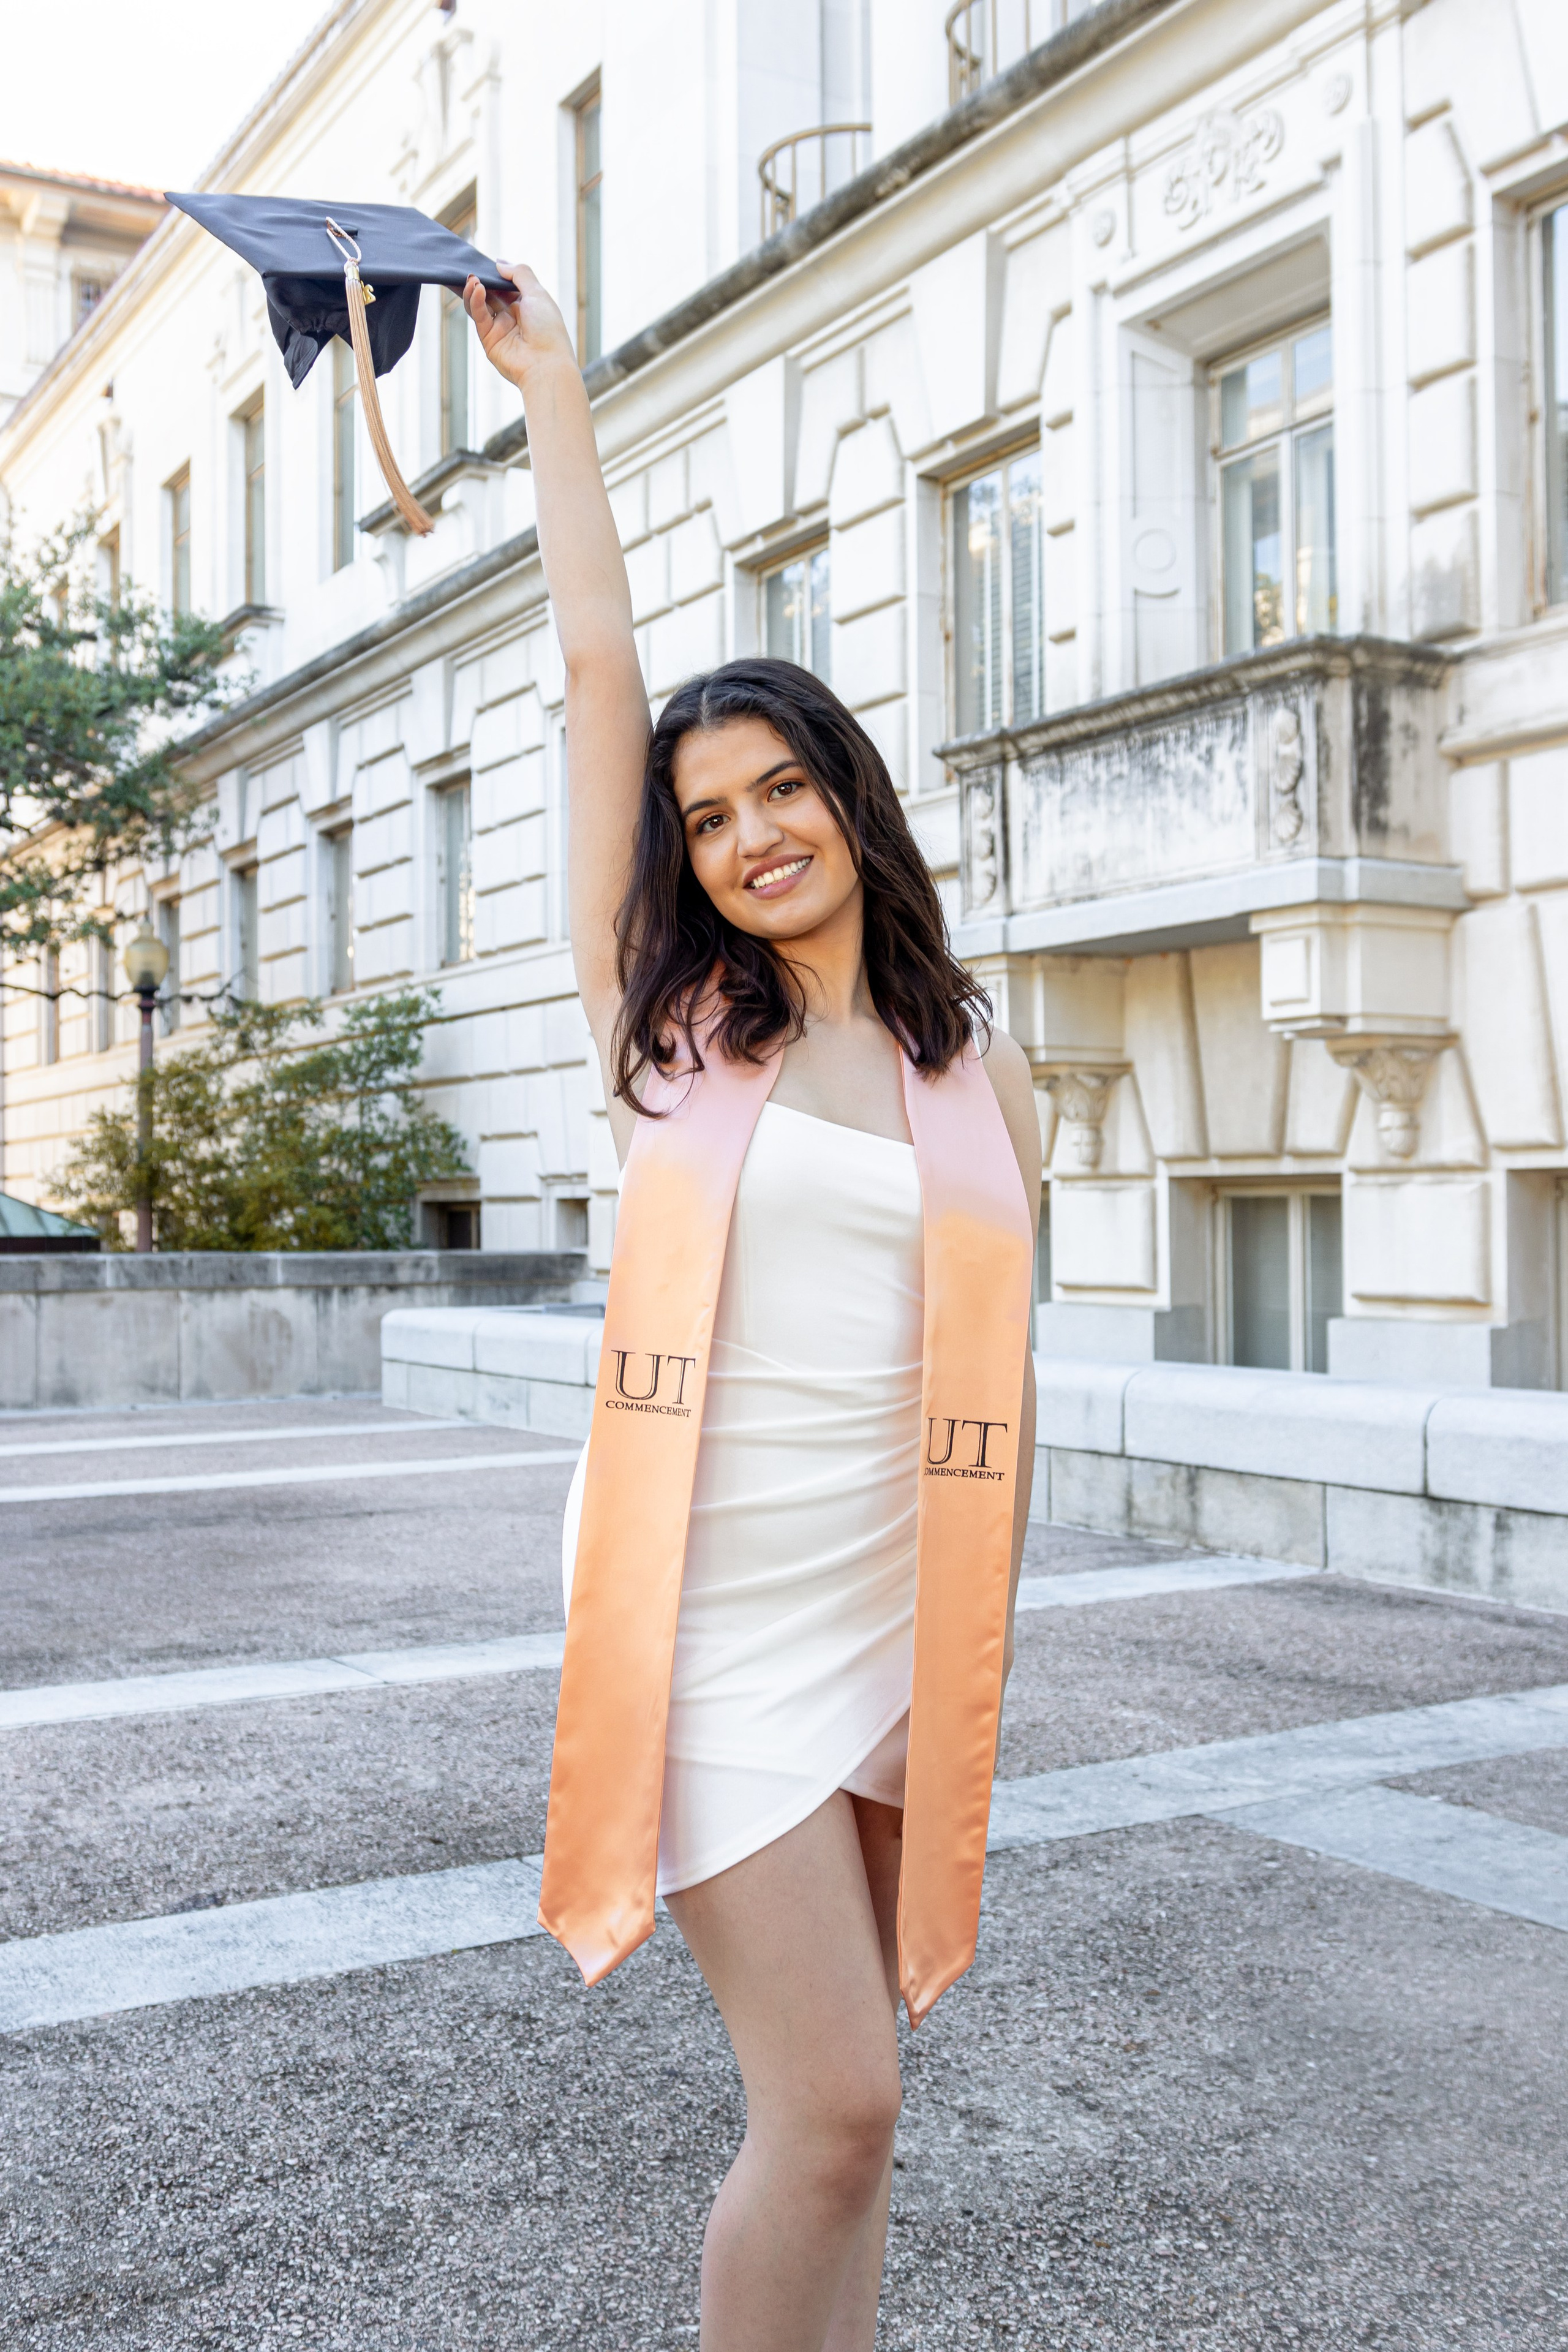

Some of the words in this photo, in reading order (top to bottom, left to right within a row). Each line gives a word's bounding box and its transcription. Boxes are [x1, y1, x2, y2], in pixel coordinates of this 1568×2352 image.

[611, 1349, 696, 1405] UT
[606, 1400, 691, 1418] COMMENCEMENT
[927, 1417, 1008, 1468] UT
[924, 1467, 1005, 1481] OMMENCEMENT
